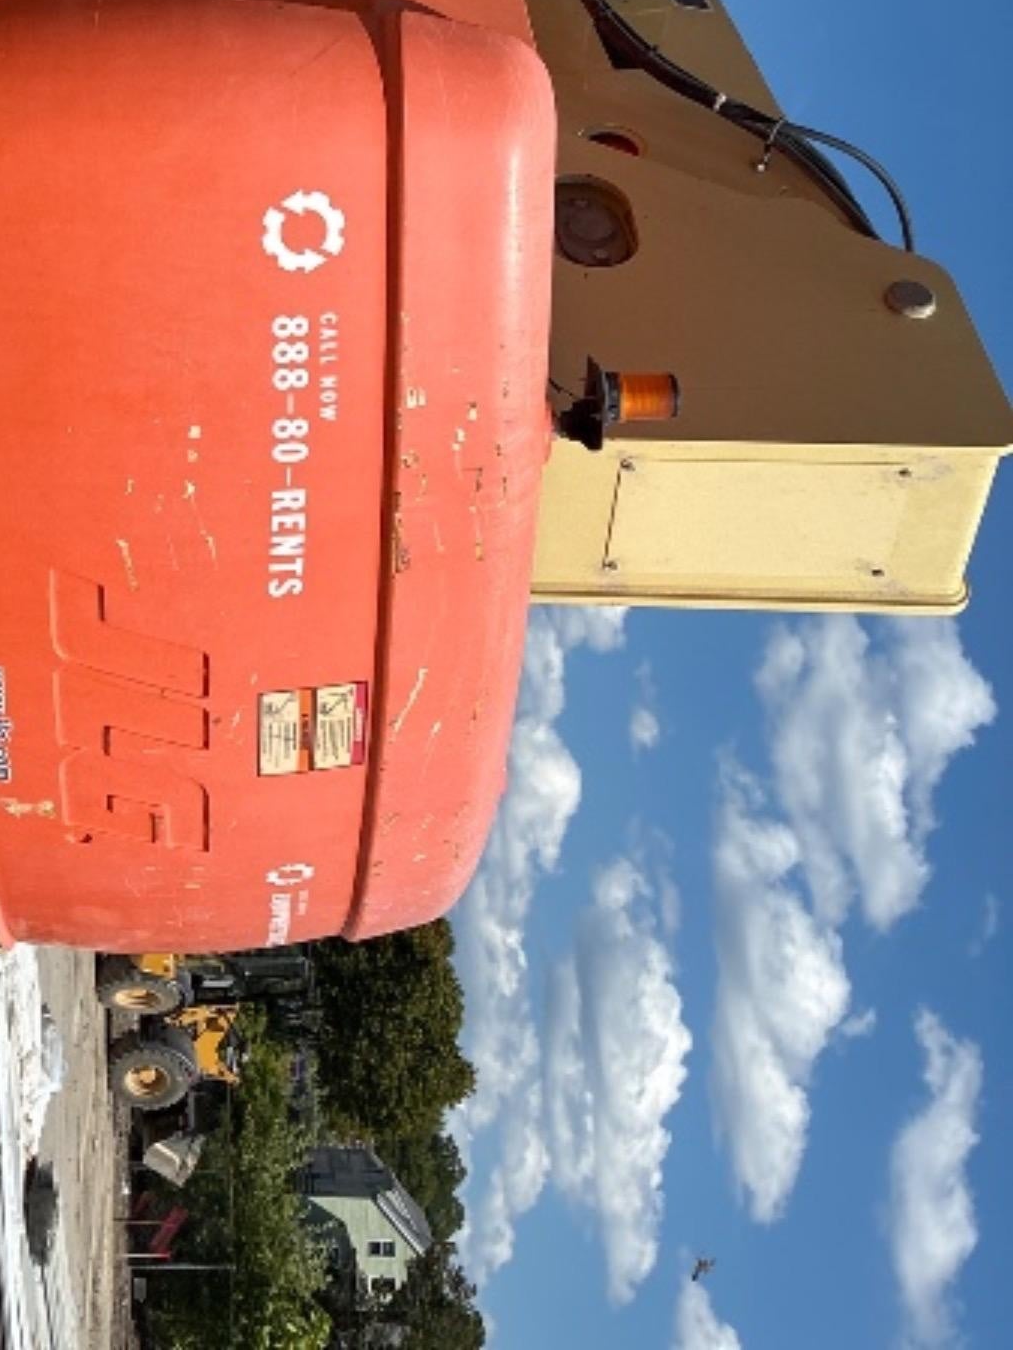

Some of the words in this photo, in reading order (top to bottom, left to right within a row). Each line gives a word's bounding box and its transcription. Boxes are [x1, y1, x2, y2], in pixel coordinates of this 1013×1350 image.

[319, 312, 338, 365] CALL
[319, 376, 337, 421] NOW
[267, 314, 310, 598] 888-80-RENTS
[49, 568, 210, 853] JLG
